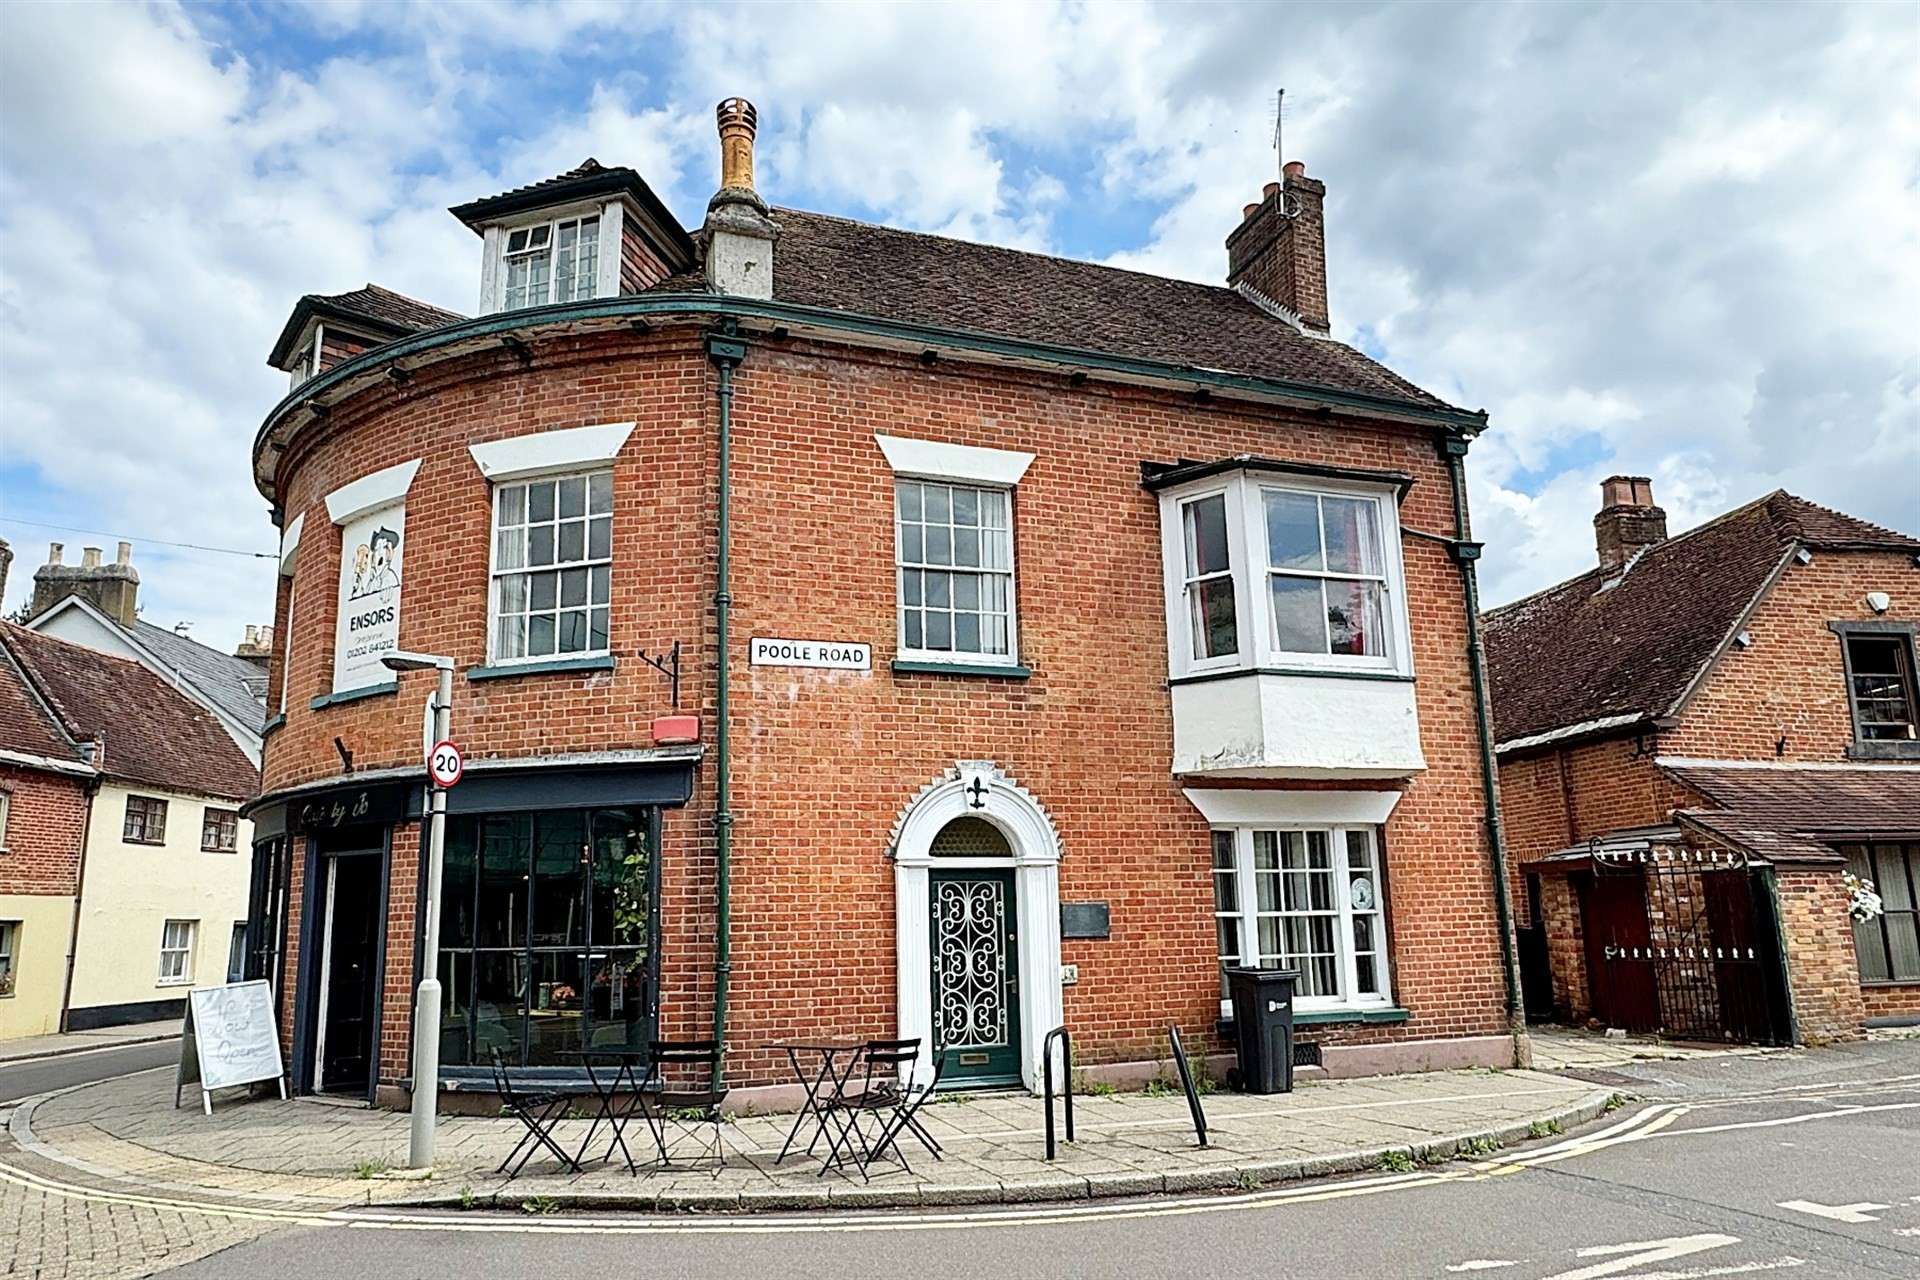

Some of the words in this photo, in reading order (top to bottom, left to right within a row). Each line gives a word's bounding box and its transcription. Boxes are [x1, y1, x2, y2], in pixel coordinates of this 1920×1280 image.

[350, 606, 394, 632] ENSORS
[347, 646, 367, 658] 01202
[758, 644, 811, 660] POOLE
[819, 648, 864, 663] ROAD
[435, 753, 458, 773] 20
[330, 801, 346, 827] by
[217, 1040, 262, 1065] Open
